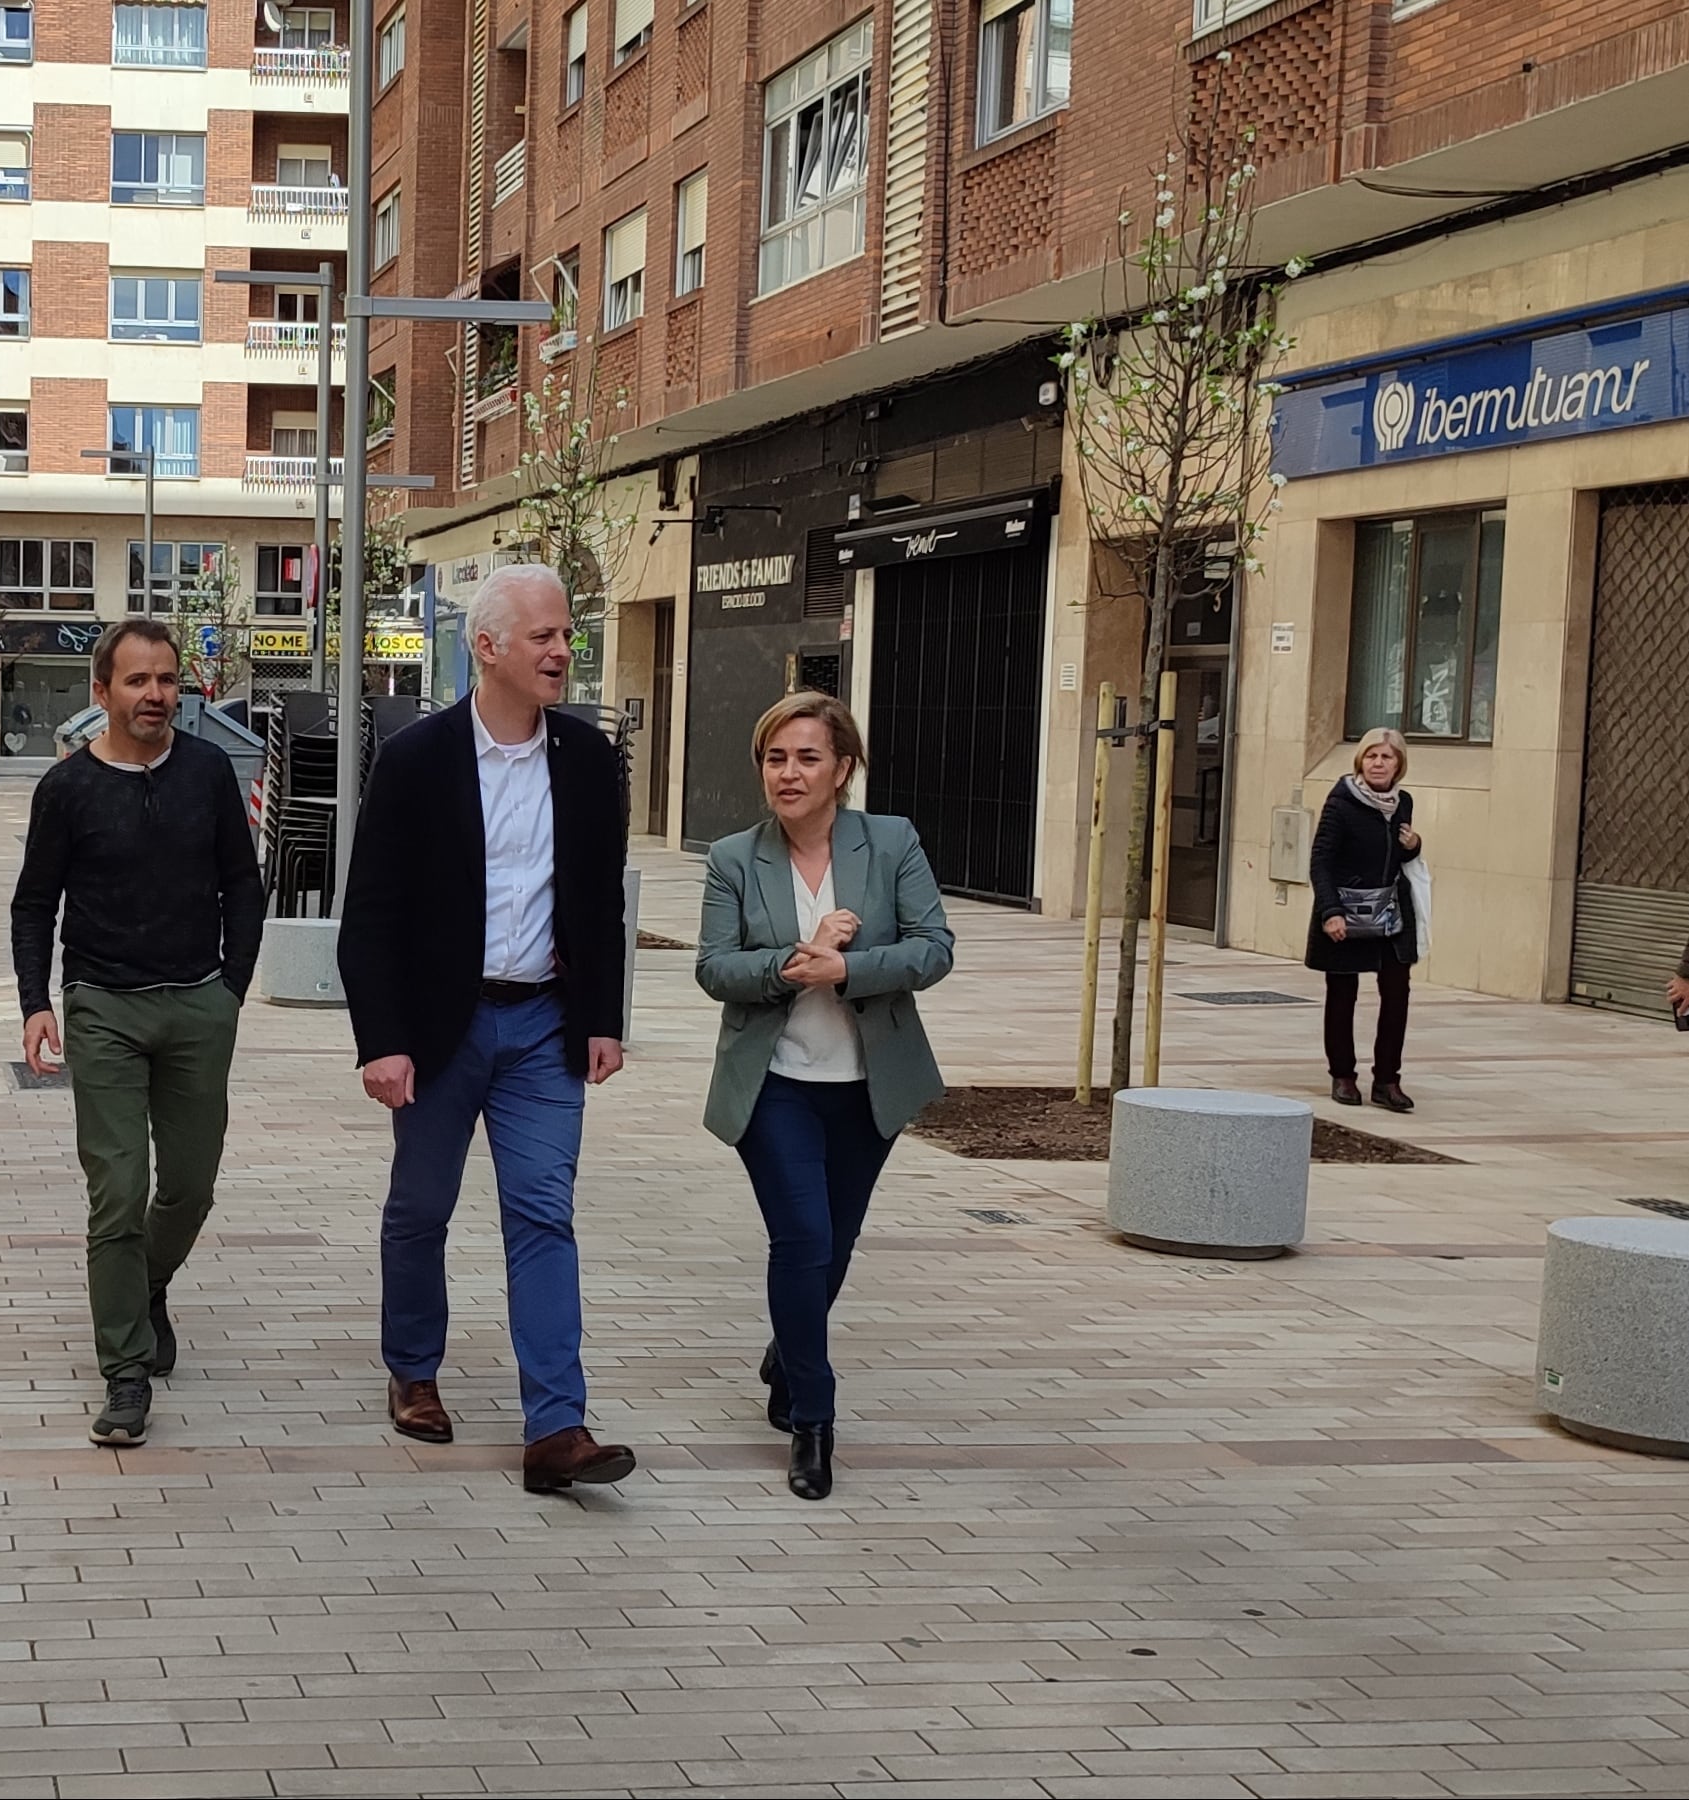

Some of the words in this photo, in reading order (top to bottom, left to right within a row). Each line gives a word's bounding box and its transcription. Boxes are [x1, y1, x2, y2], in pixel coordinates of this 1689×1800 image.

[1416, 359, 1650, 445] ibermutuamur
[697, 561, 740, 592] FRIENDS
[741, 560, 750, 587] &
[751, 555, 795, 587] FAMILY
[281, 635, 303, 647] ME
